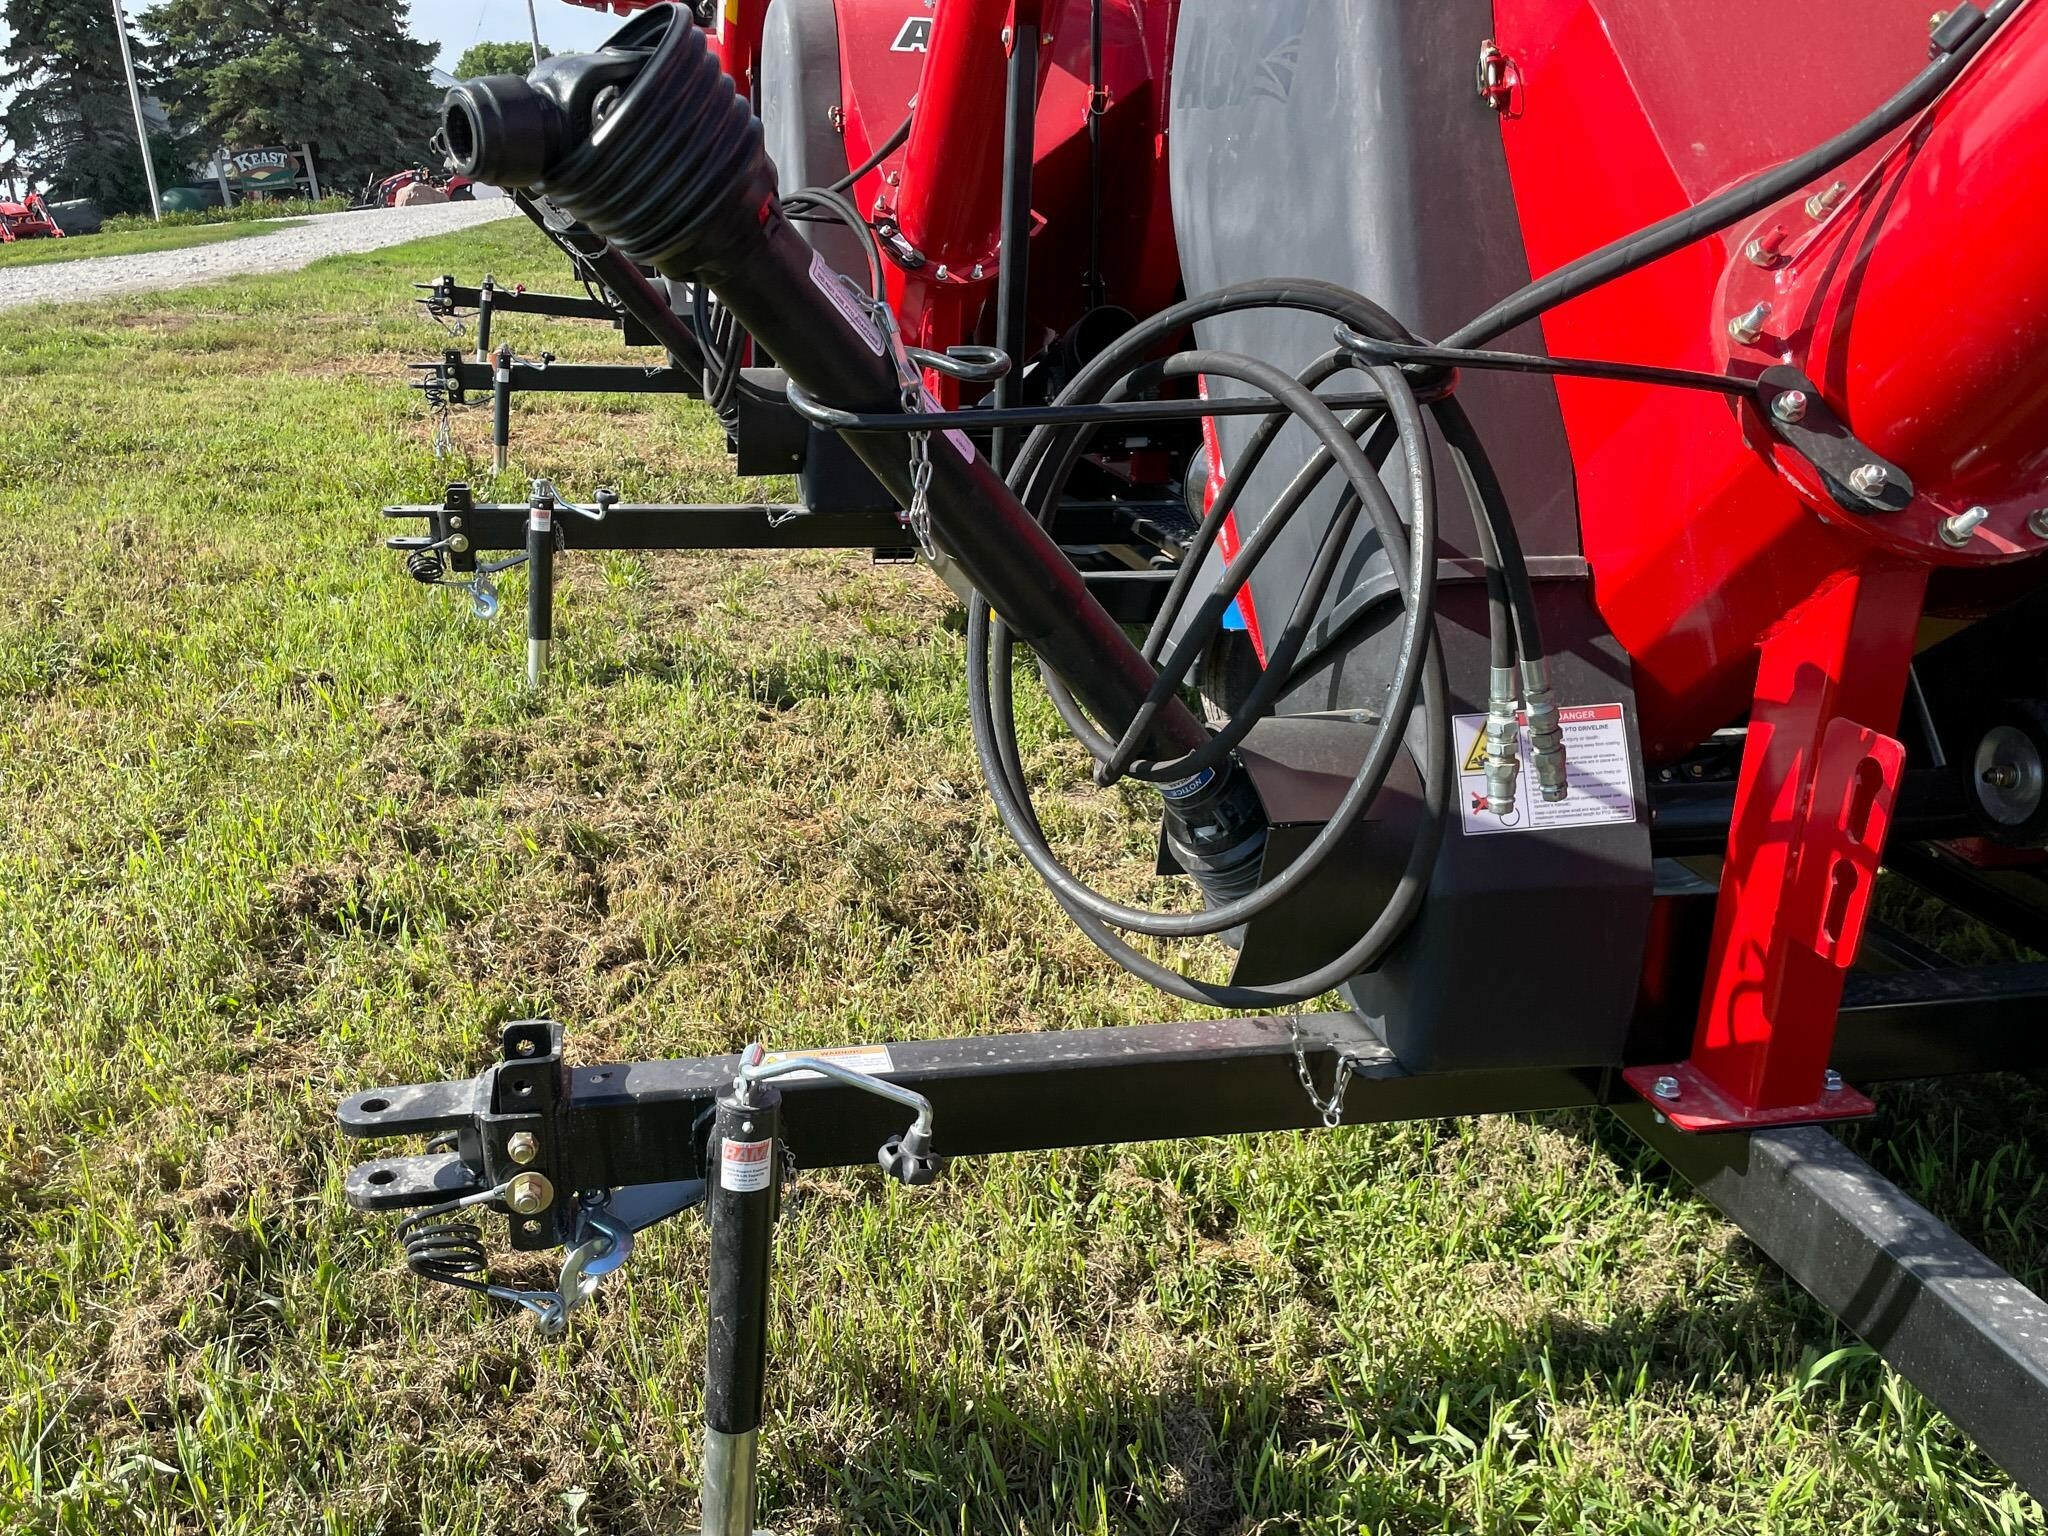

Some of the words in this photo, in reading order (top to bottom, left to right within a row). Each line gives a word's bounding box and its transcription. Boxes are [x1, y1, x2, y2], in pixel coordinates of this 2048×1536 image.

[233, 152, 287, 172] KEAST
[1578, 724, 1609, 732] DRIVELINE
[1171, 779, 1202, 797] NOTICE
